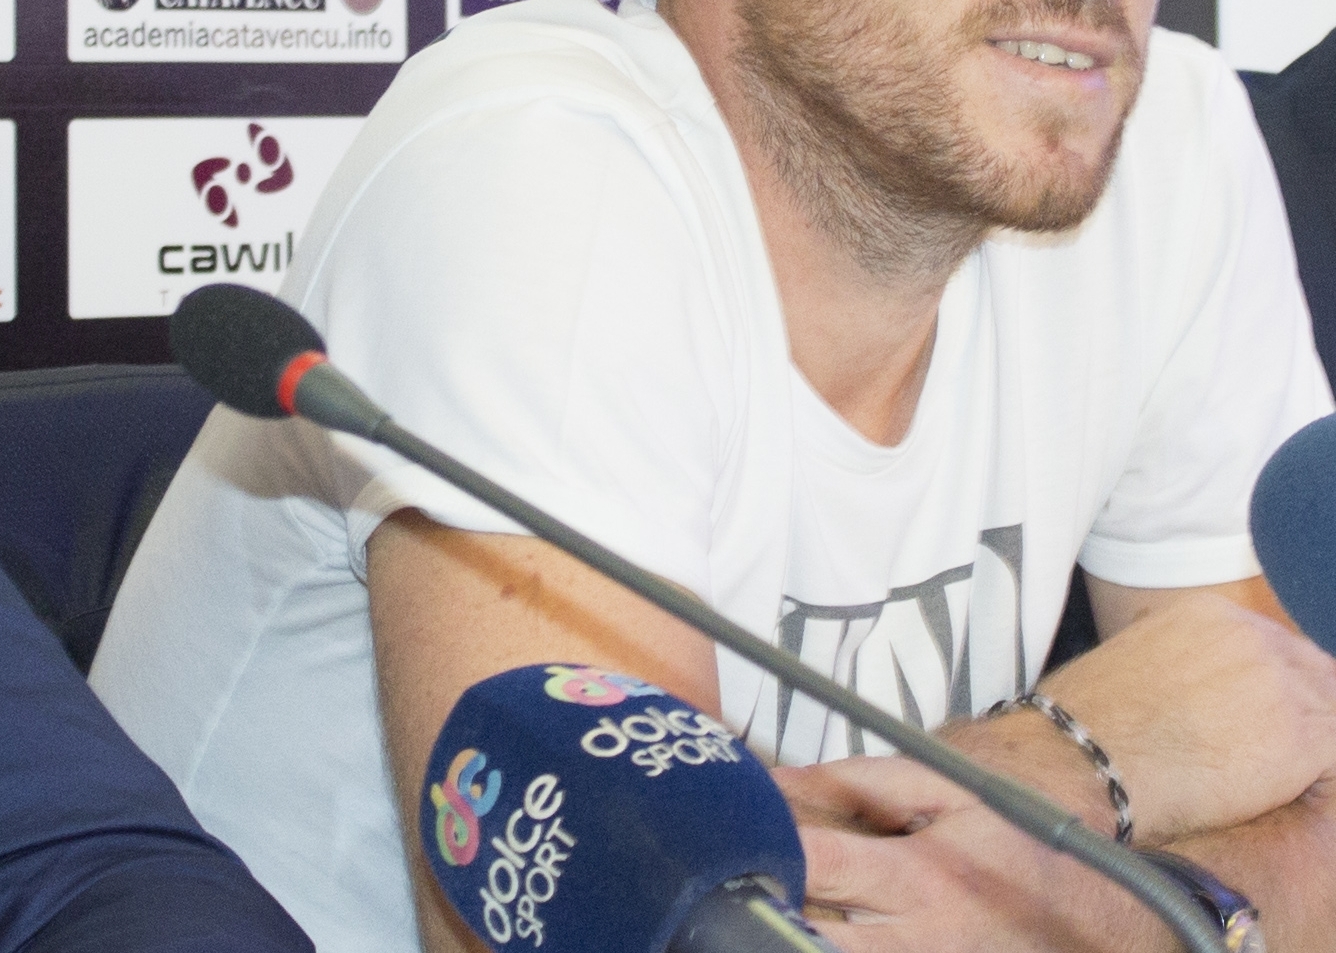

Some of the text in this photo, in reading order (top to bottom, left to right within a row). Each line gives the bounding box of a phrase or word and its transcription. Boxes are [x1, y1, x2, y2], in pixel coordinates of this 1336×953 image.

[84, 21, 392, 49] academiacatavencu.info
[480, 773, 564, 944] dolce
[516, 817, 577, 947] SPORT
